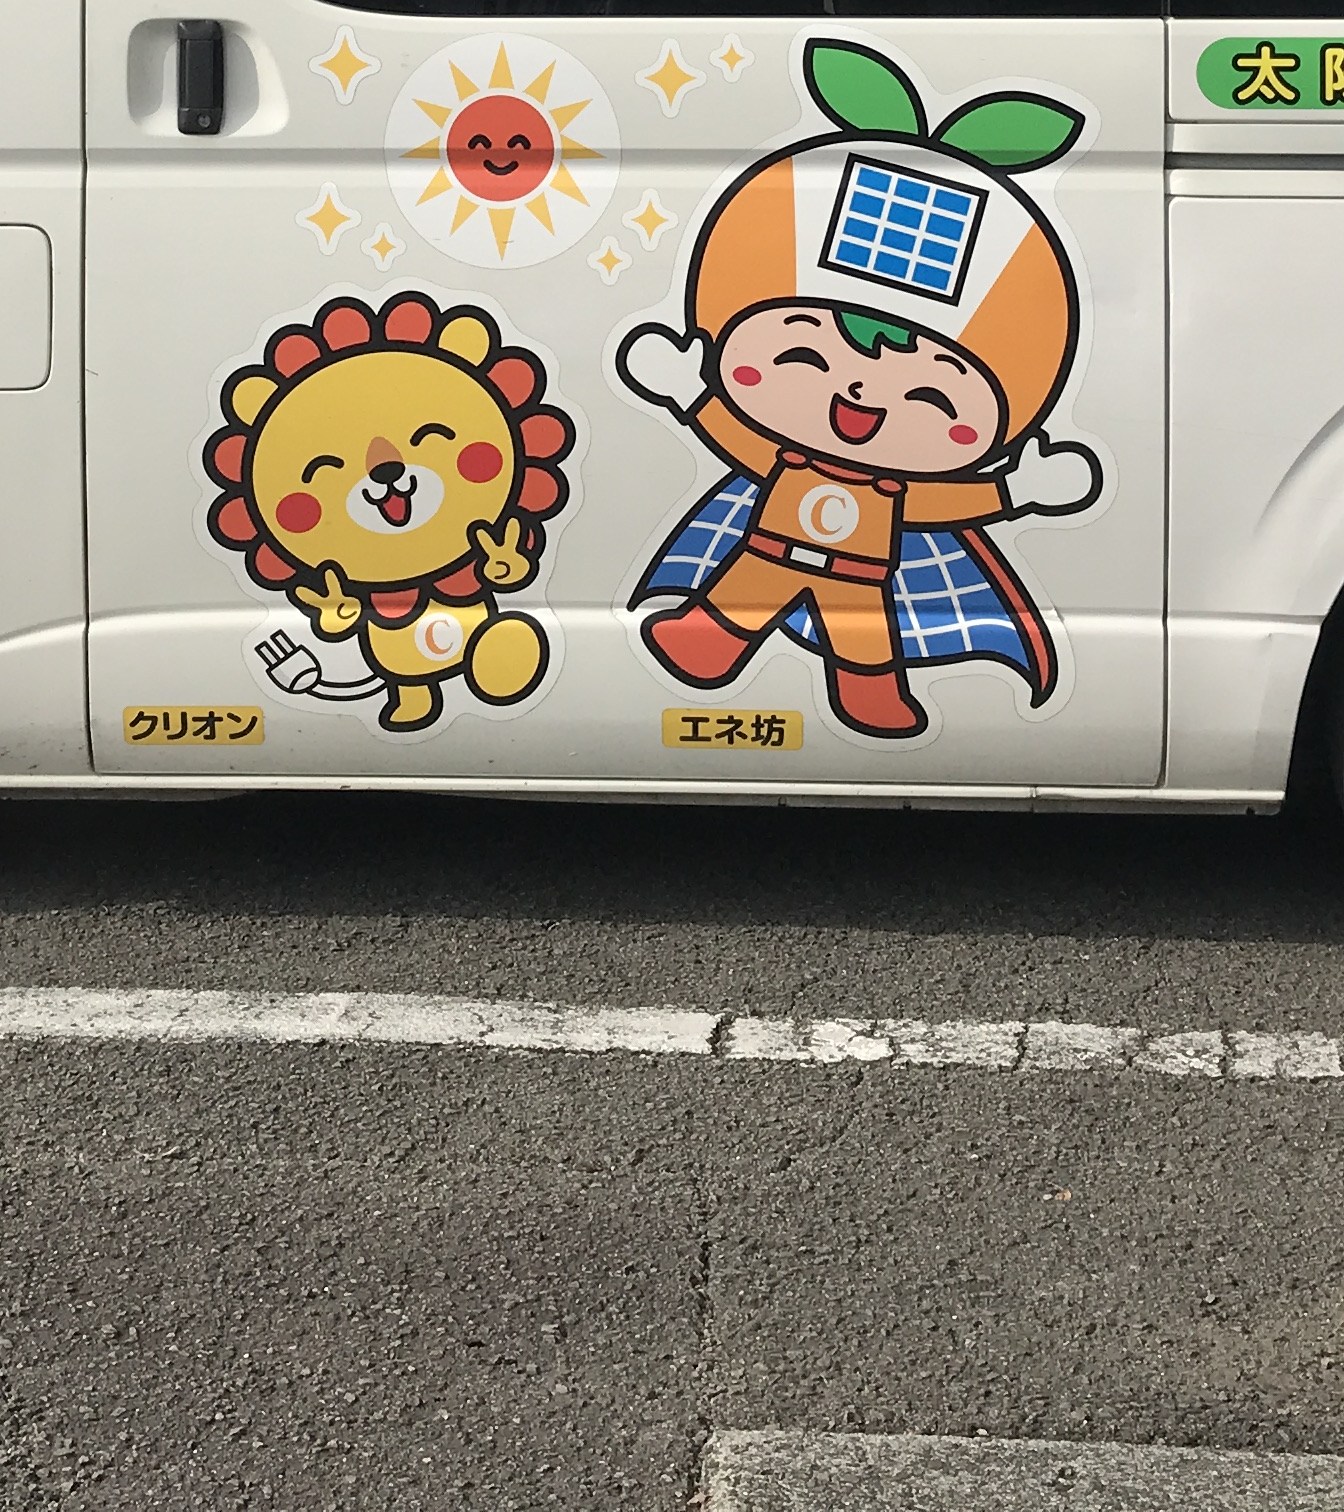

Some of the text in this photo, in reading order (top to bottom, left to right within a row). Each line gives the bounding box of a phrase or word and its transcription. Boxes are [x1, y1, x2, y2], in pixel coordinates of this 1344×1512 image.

[810, 494, 846, 536] C
[424, 619, 454, 656] C
[129, 710, 258, 741] クリオン
[679, 714, 787, 747] エネ坊
